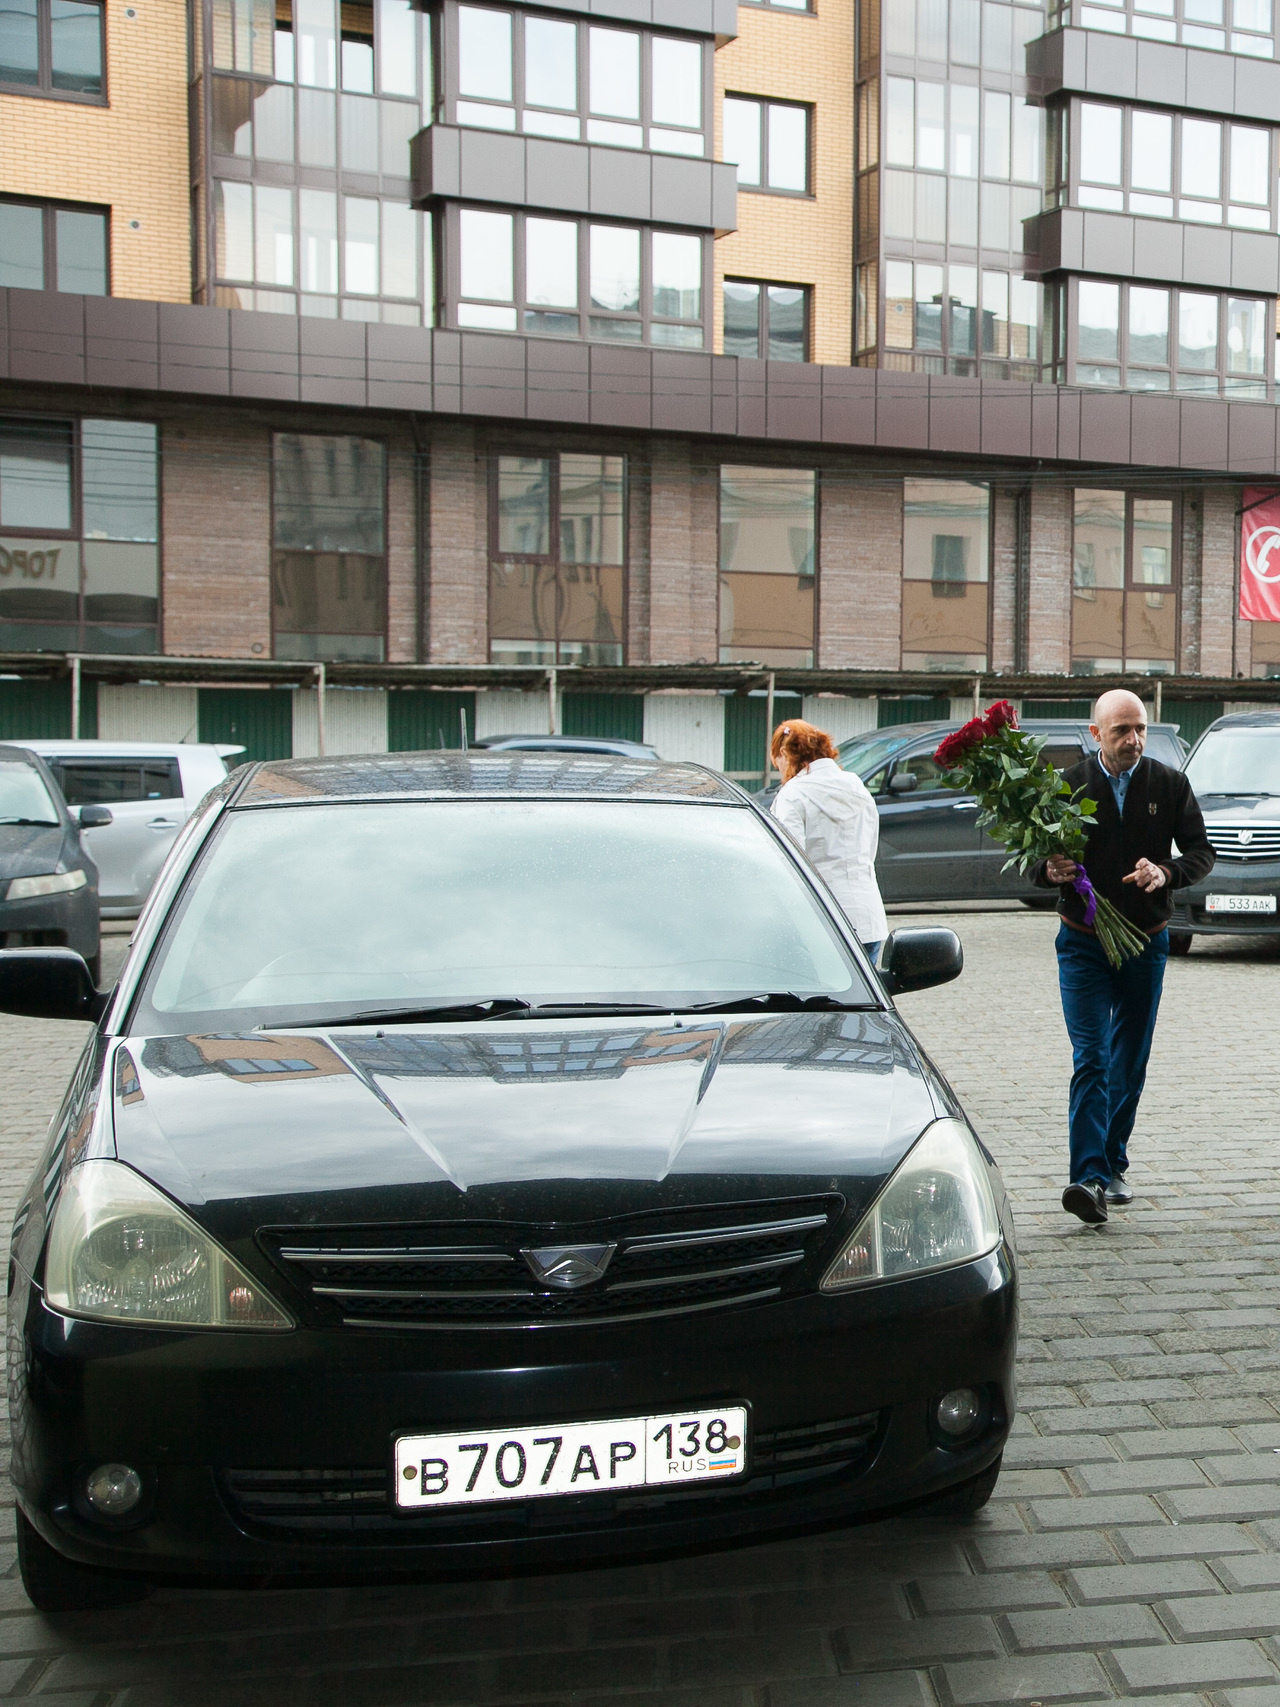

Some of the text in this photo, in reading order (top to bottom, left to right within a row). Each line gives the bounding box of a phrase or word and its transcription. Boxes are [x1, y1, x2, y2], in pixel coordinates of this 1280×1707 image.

[1229, 898, 1250, 910] 533
[652, 1418, 728, 1460] 138
[668, 1458, 707, 1475] RUS
